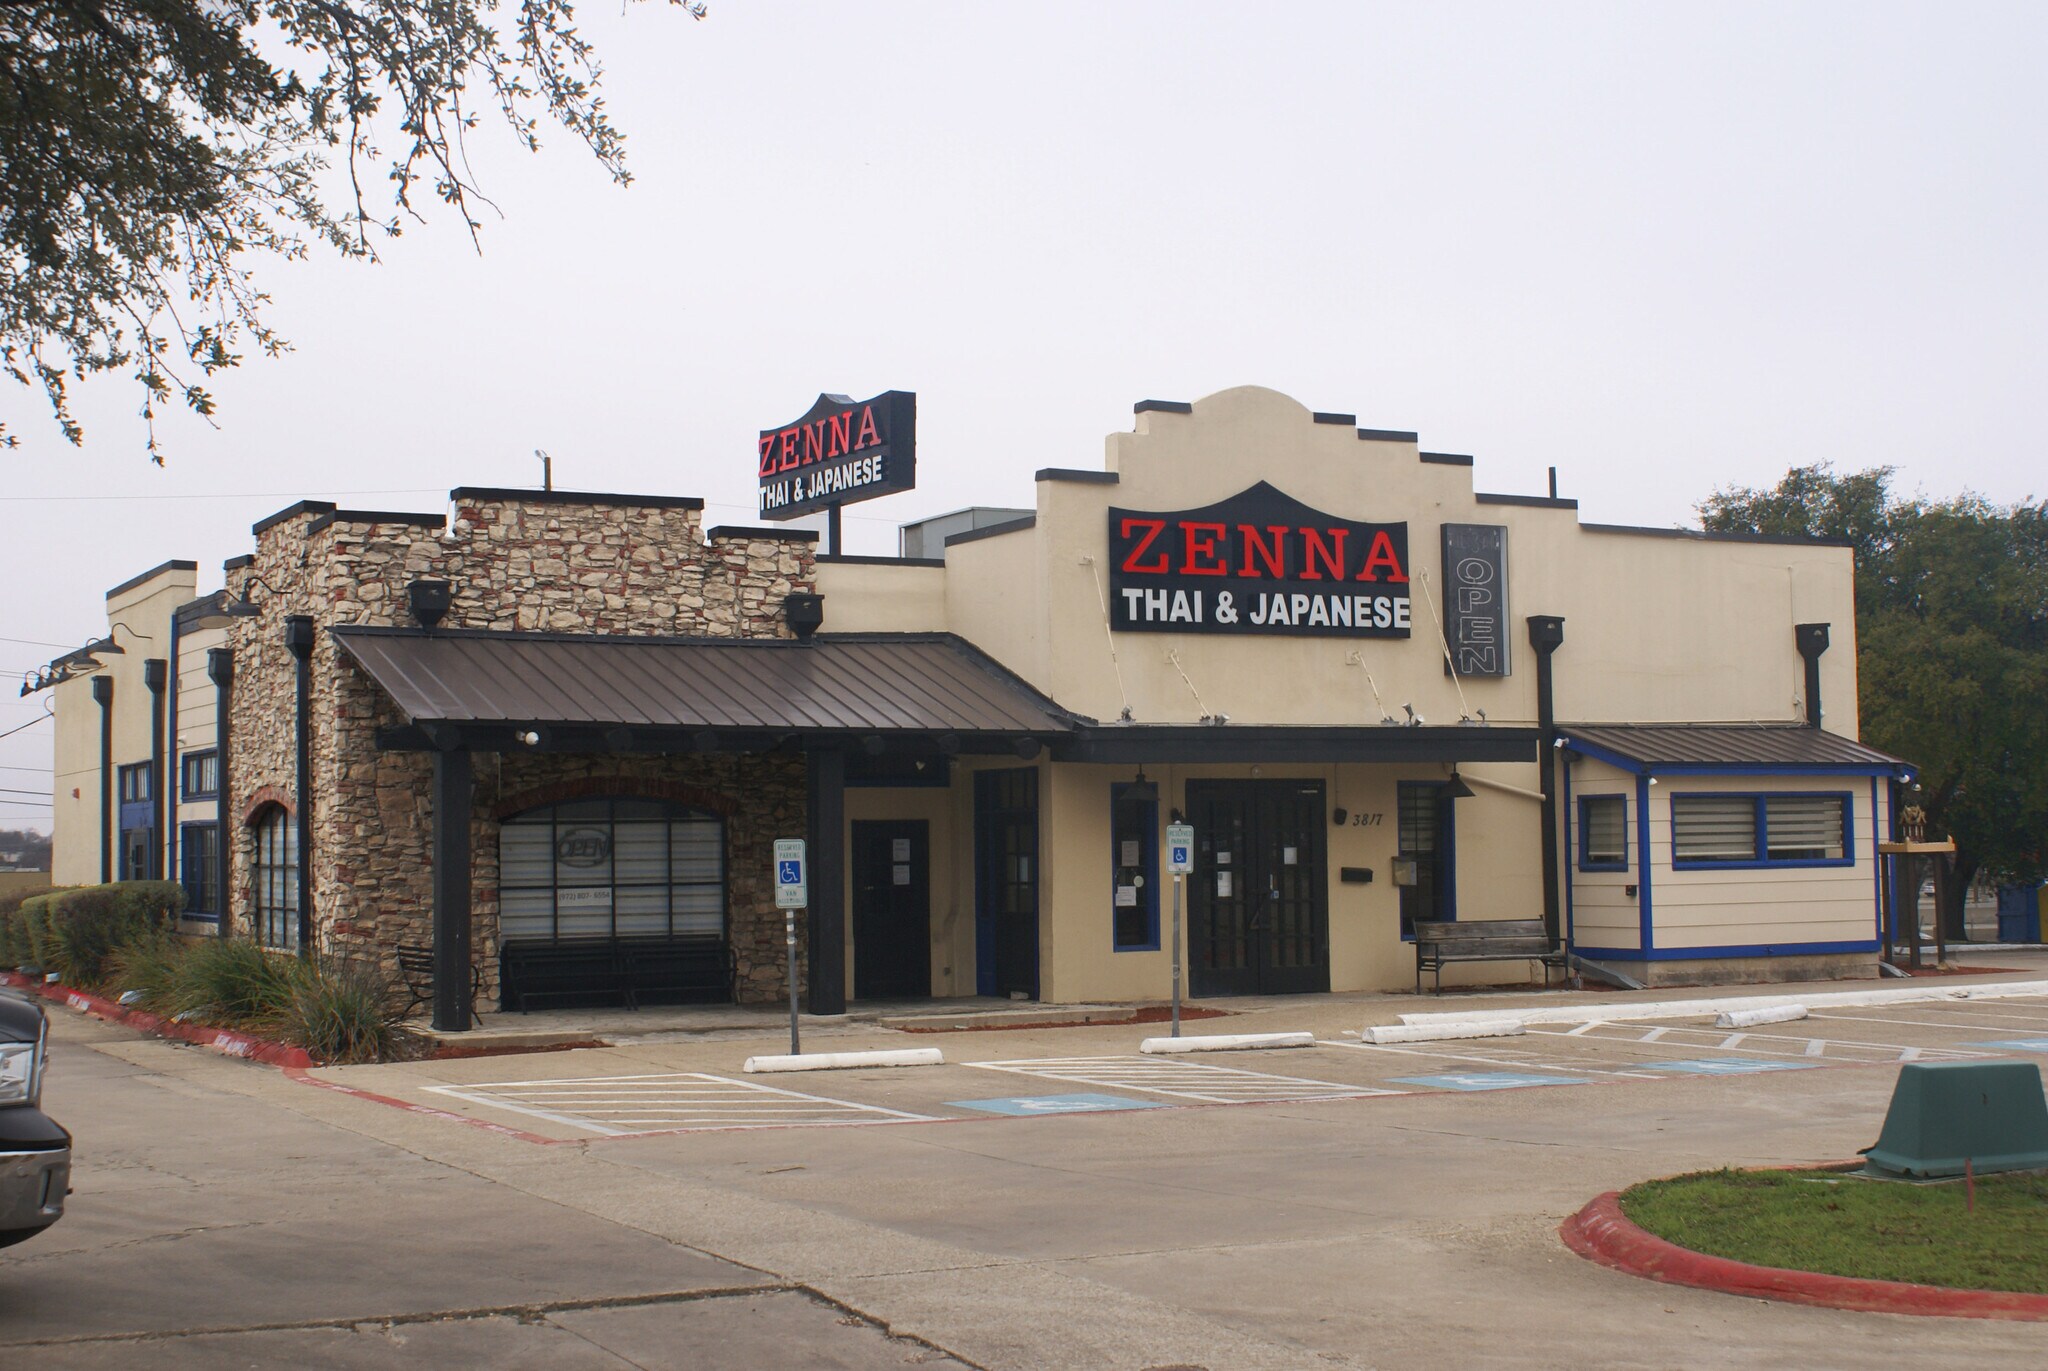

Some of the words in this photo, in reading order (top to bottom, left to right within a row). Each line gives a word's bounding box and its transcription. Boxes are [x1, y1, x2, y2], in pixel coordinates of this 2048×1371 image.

[758, 405, 882, 478] ZENNA
[758, 480, 789, 511] THAI
[793, 477, 804, 502] &
[807, 455, 882, 499] JAPANESE
[1121, 518, 1410, 583] ZENNA
[1122, 588, 1203, 623] THAI
[1215, 590, 1239, 624] &
[1250, 592, 1411, 629] JAPANESE
[1456, 557, 1497, 674] OPEN
[1352, 813, 1384, 827] 3817
[559, 837, 610, 858] OPEN
[784, 889, 797, 897] VAN
